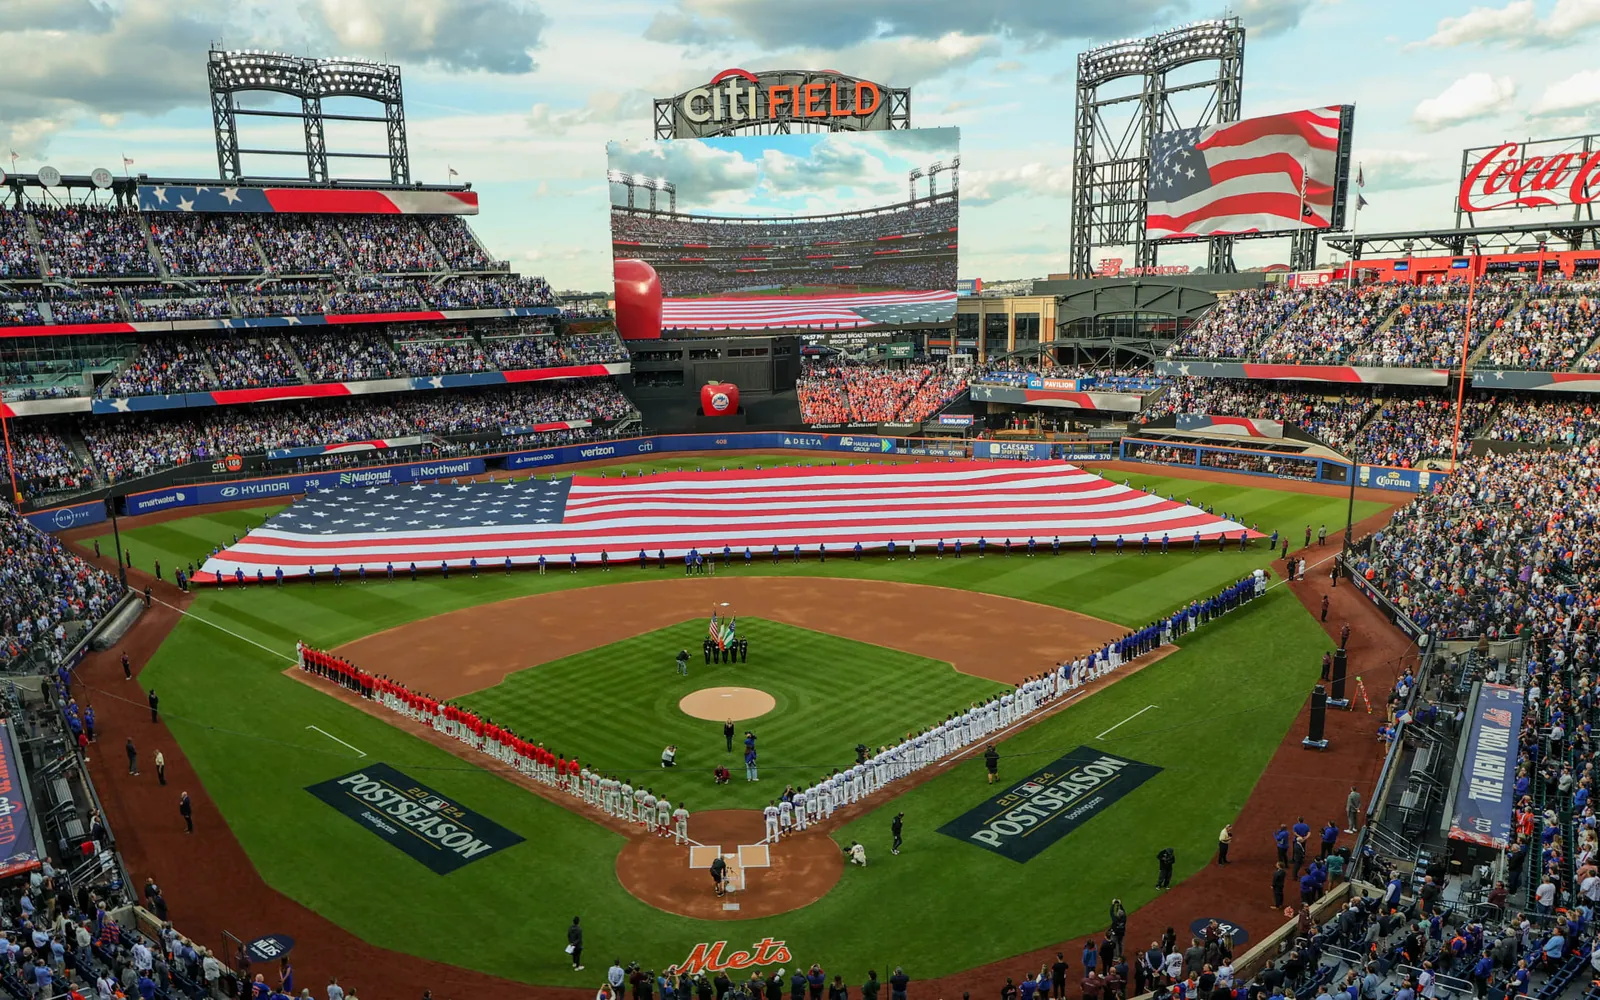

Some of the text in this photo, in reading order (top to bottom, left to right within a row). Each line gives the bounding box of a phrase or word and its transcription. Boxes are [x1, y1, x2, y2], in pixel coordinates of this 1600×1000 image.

[683, 78, 880, 122] citi FIELD
[96, 173, 109, 182] 42
[1146, 264, 1190, 275] balance
[1044, 381, 1074, 389] PAVILION
[580, 445, 614, 458] verizon
[638, 441, 653, 452] citi
[1001, 443, 1034, 451] CAESARS
[352, 469, 391, 482] National
[421, 463, 469, 477] Northwell
[241, 481, 290, 495] HYUNDAI
[305, 479, 320, 488] 358
[1376, 475, 1411, 488] Corona
[138, 495, 176, 509] smartwater
[1477, 725, 1510, 753] YORK
[1472, 751, 1506, 780] NEW
[996, 772, 1056, 807] 20 24
[1468, 777, 1503, 803] THE
[408, 787, 466, 820] 20 24
[970, 756, 1129, 848] POSTSEASON
[1064, 796, 1104, 821] Booking.com
[337, 773, 493, 859] POSTSEASON
[361, 811, 398, 835] Booking.com
[1475, 817, 1492, 833] citi
[253, 939, 281, 957] NLDS
[667, 937, 792, 976] Mets
